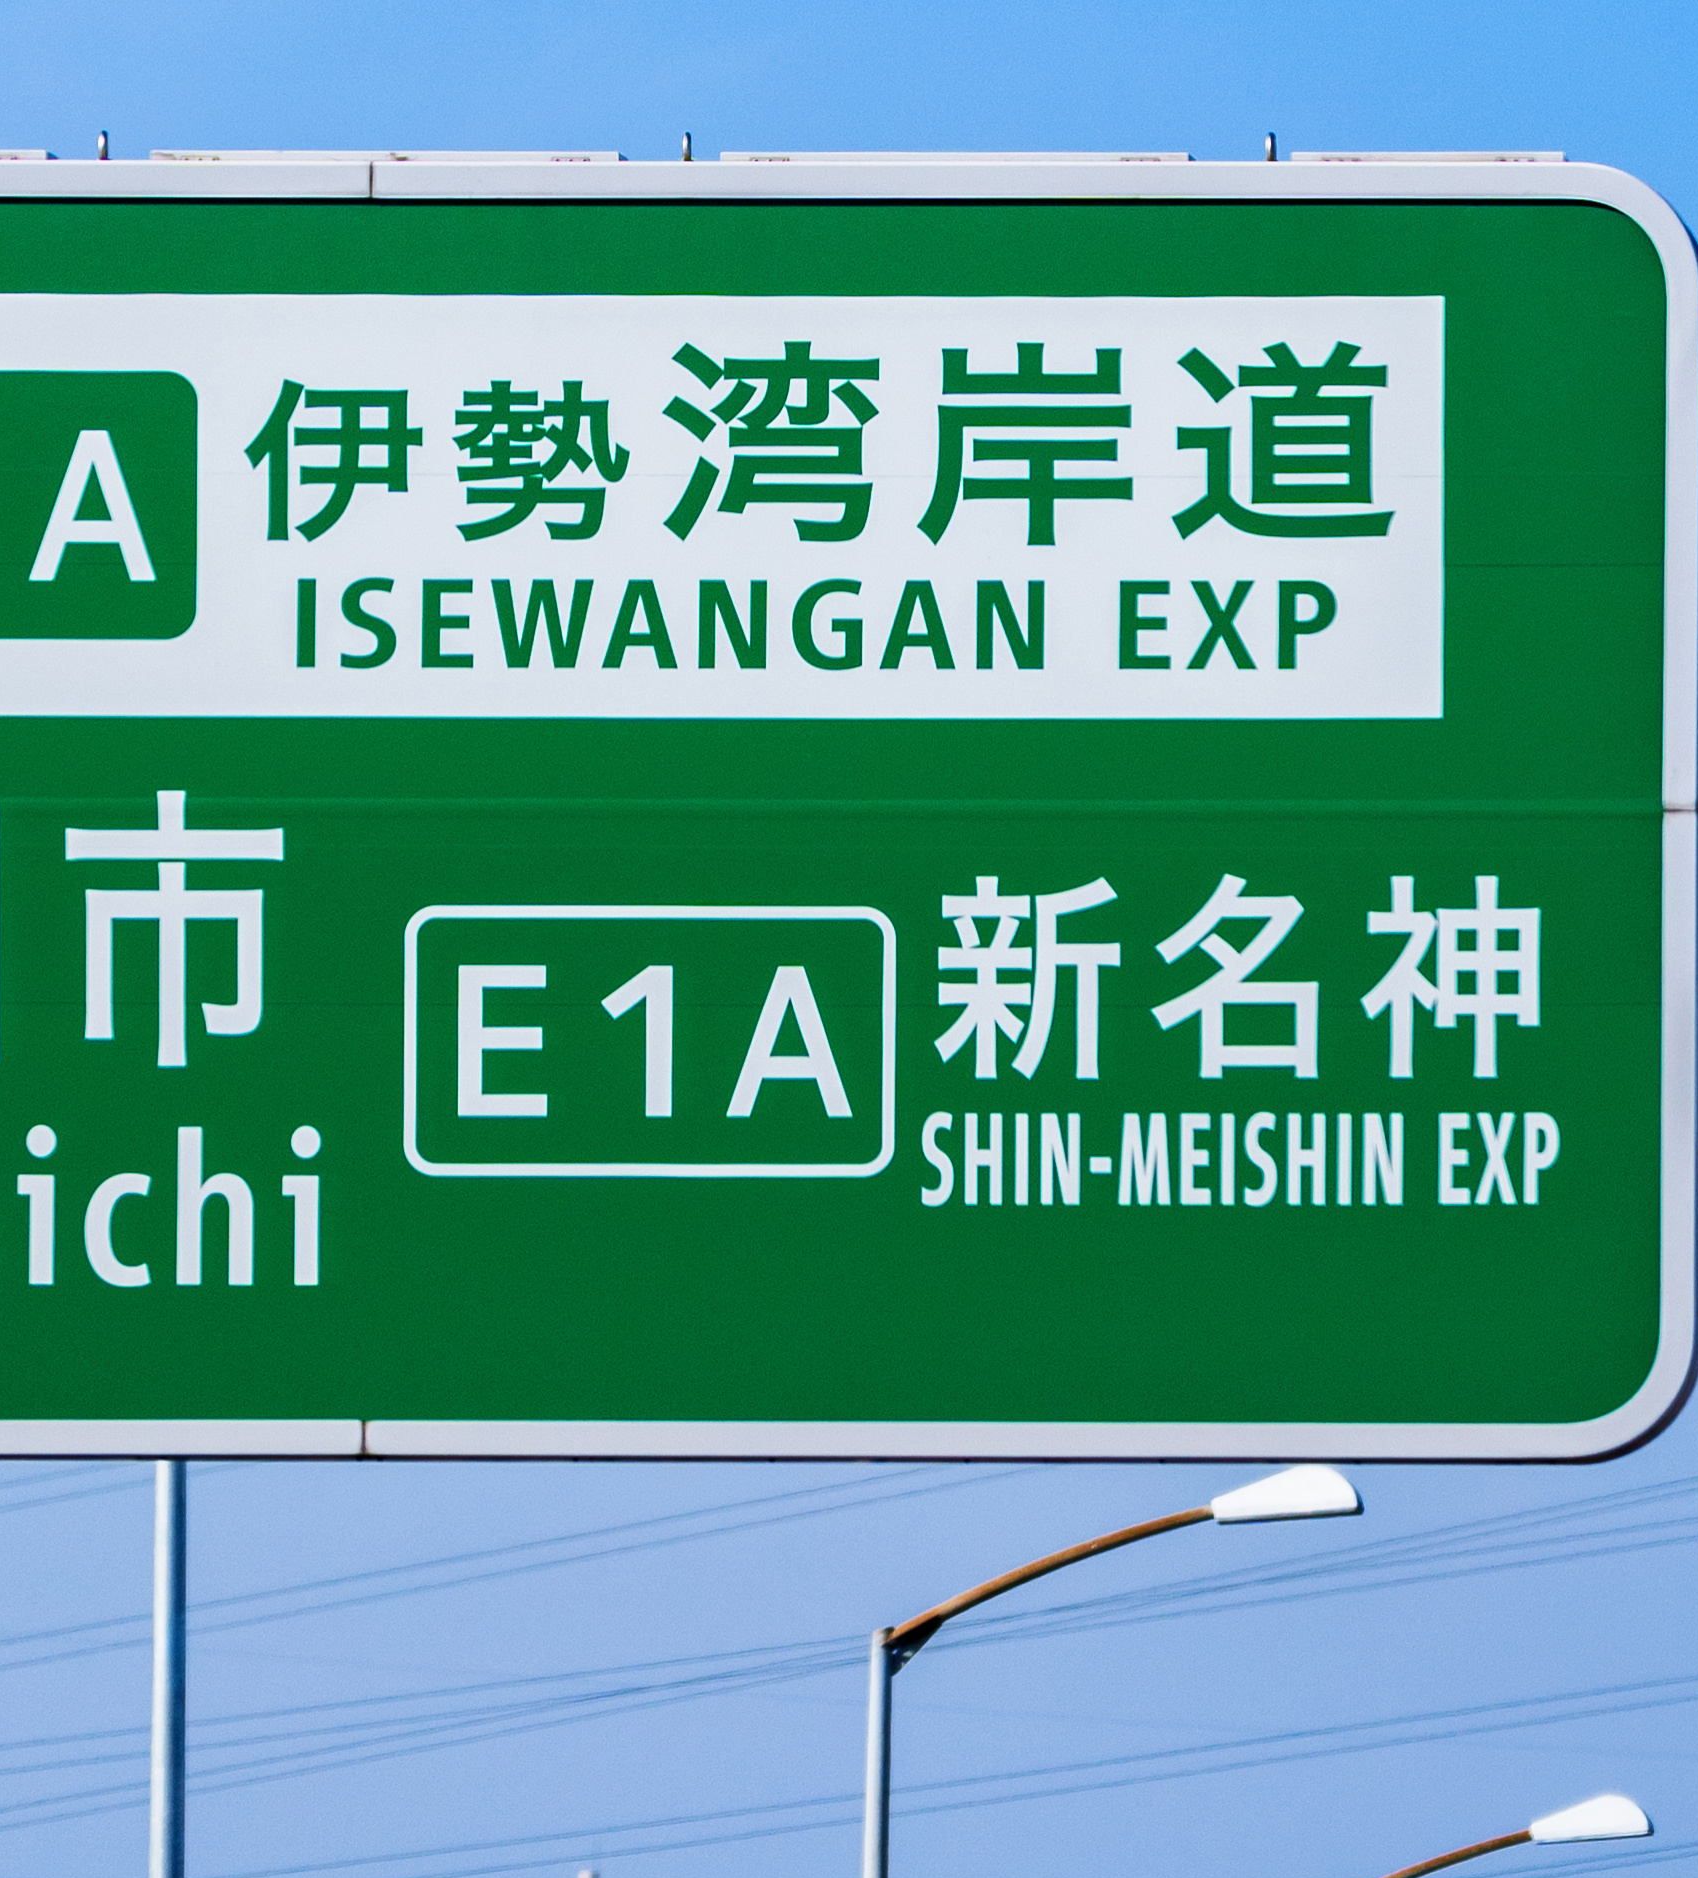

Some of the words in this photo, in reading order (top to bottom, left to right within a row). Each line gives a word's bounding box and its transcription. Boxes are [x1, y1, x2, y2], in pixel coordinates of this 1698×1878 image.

[242, 340, 1396, 546] 伊勢湾岸道
[296, 576, 1046, 671] ISEWANGAN
[1117, 578, 1339, 670] EXP
[458, 964, 853, 1117] E1A
[933, 873, 1541, 1079] 新名神
[920, 1111, 1404, 1206] SHIN-MEISHIN
[1438, 1112, 1560, 1206] EXP
